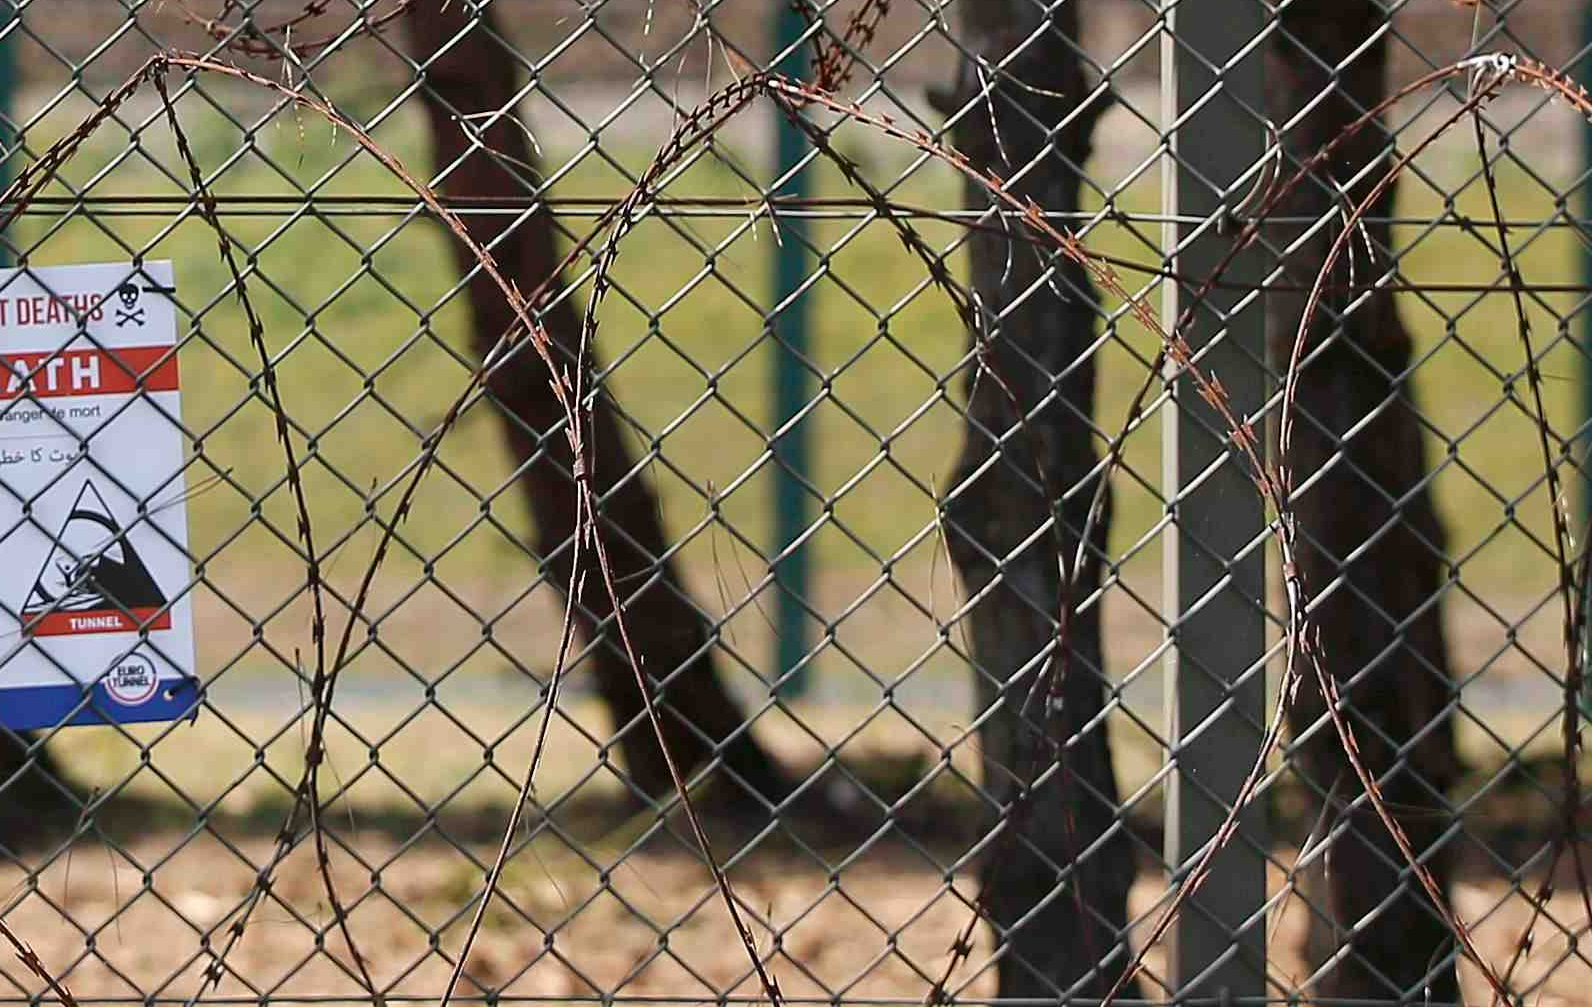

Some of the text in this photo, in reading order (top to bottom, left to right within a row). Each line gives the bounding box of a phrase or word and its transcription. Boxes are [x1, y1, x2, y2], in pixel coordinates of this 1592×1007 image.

[16, 294, 104, 326] DEATHS
[69, 405, 101, 418] mort
[69, 616, 123, 630] TUNNEL
[116, 664, 145, 677] EURO
[111, 675, 151, 688] TUNNEL
